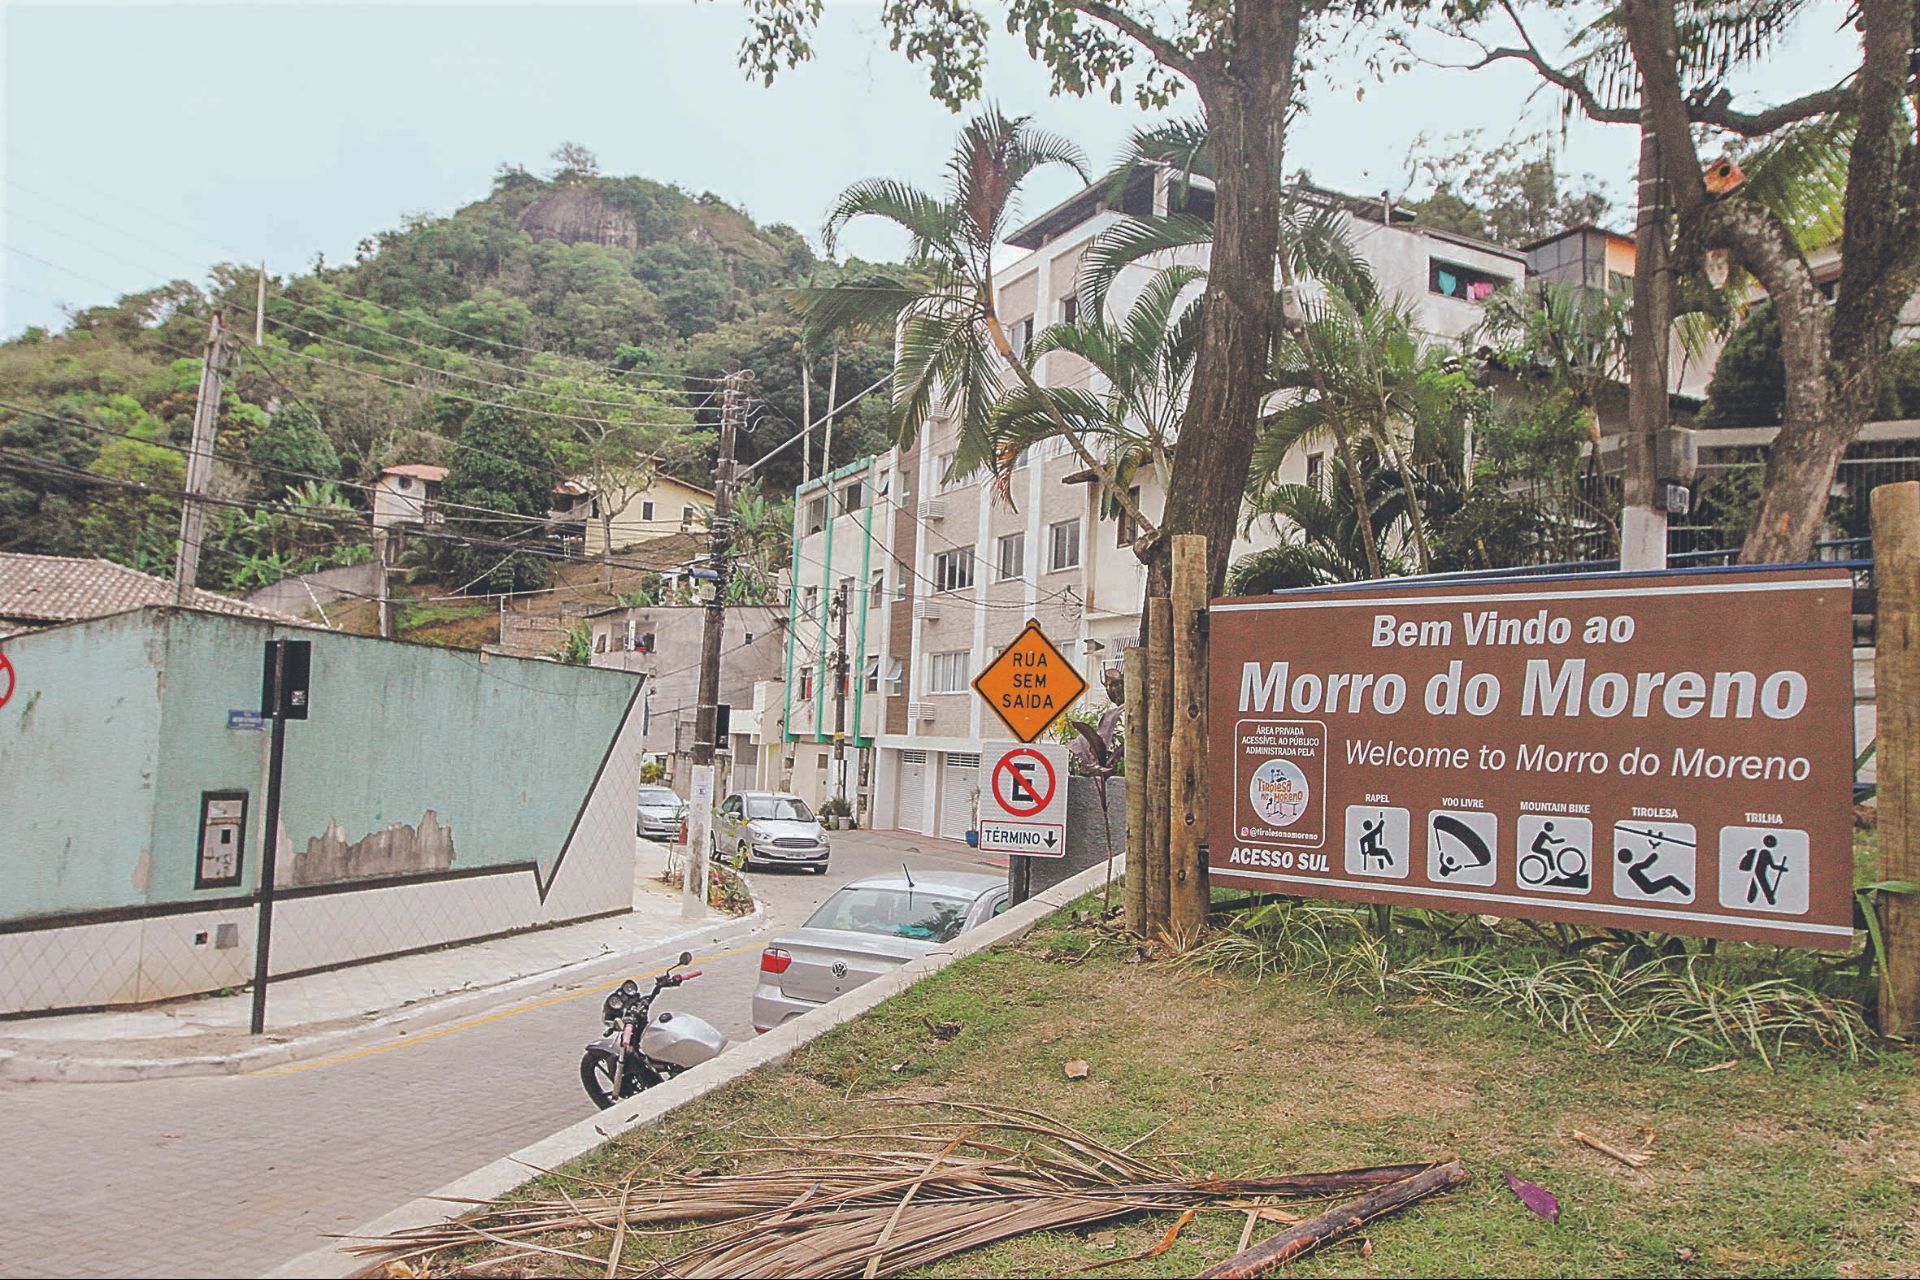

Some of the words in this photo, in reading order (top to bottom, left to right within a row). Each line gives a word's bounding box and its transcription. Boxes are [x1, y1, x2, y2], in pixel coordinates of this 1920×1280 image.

[1372, 614, 1452, 647] Bem
[1463, 609, 1572, 646] Vindo
[1582, 614, 1636, 644] ao
[1012, 652, 1048, 668] RUA
[1012, 673, 1047, 690] SEM
[1238, 661, 1408, 715] Morro
[1424, 659, 1501, 717] do
[1520, 658, 1808, 720] Moreno
[1002, 691, 1054, 709] SAÍDA
[1256, 725, 1274, 735] ÁREA
[1275, 727, 1304, 736] PRIVADA
[1241, 735, 1277, 745] ACESSÍVEL
[1278, 737, 1288, 745] AO
[1289, 735, 1320, 747] PÚBLICO
[1245, 746, 1297, 756] ADMINISTRADA
[1297, 748, 1315, 757] PELA
[1346, 739, 1470, 770] Welcome
[1479, 745, 1506, 771] to
[1516, 744, 1609, 774] Morro
[1618, 746, 1660, 776] do
[1671, 747, 1811, 781] Moreno
[1365, 793, 1390, 803] RAPEL
[1442, 797, 1459, 807] VOO
[1460, 798, 1484, 808] LIVRE
[1520, 802, 1567, 813] MOUNTAIN
[1568, 803, 1590, 814] BIKE
[1632, 806, 1679, 819] TIROLESA
[1744, 812, 1784, 824] TRILHA
[984, 826, 1041, 845] TÉRMINO
[1250, 827, 1319, 841] @tirolesanomoreno
[1229, 847, 1294, 869] ACESSO
[1297, 852, 1330, 872] SUL
